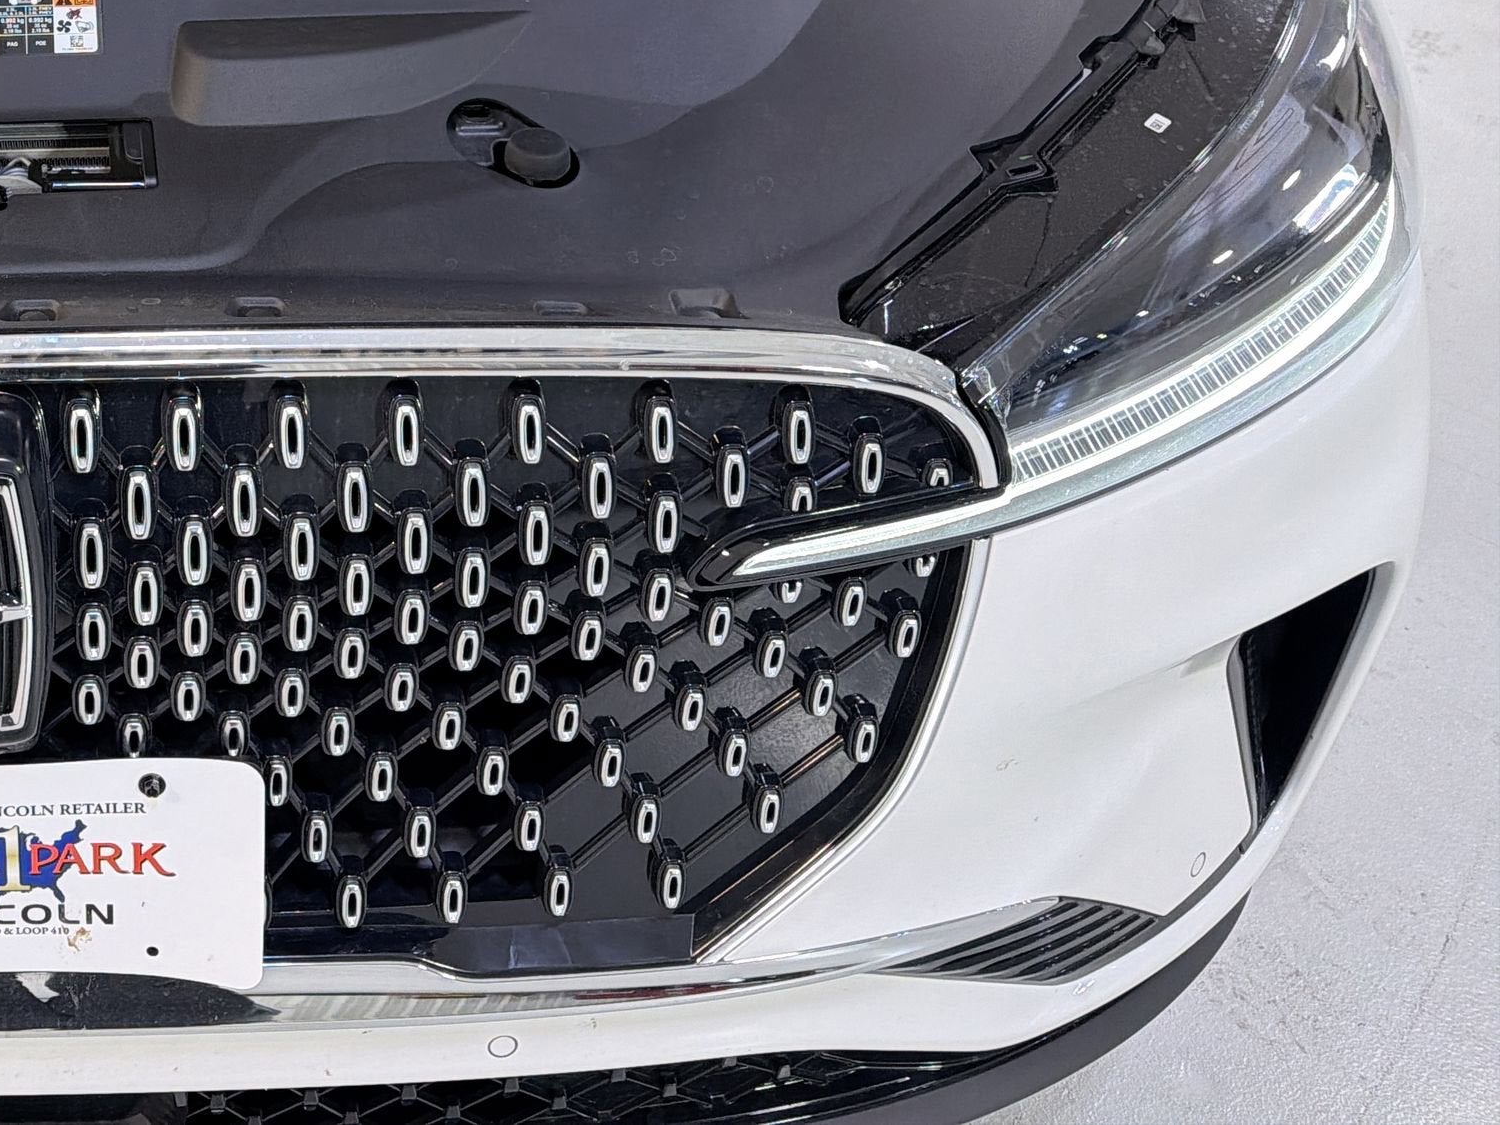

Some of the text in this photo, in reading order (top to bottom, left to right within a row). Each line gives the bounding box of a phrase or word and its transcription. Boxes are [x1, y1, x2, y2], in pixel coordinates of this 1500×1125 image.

[60, 802, 147, 816] RETAILER
[29, 842, 177, 876] PARK
[3, 927, 14, 936] &
[16, 926, 49, 935] LOOP
